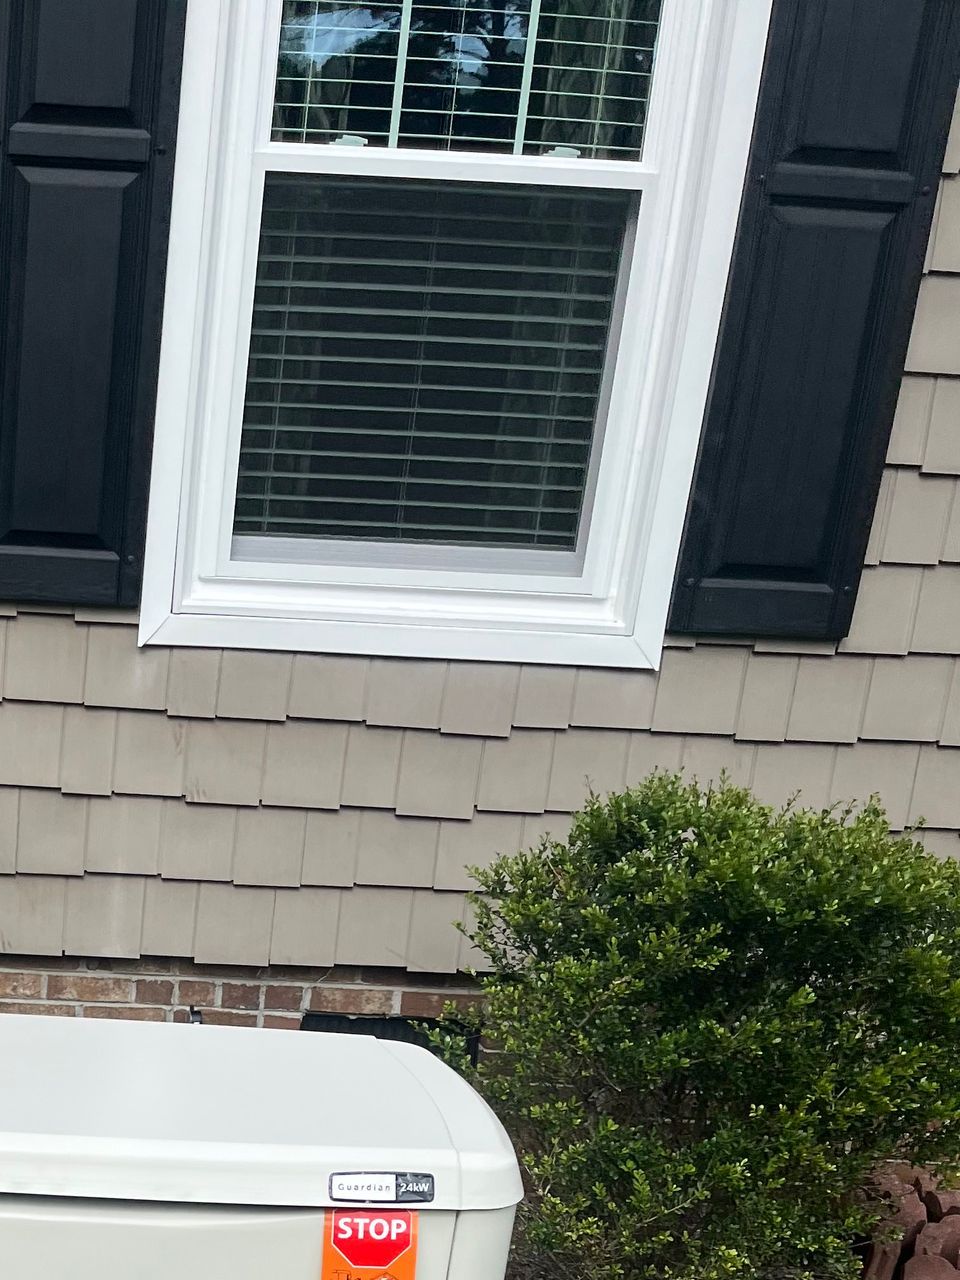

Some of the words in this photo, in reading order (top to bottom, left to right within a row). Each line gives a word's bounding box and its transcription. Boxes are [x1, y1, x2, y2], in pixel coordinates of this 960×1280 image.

[338, 1183, 391, 1191] Guardian
[400, 1183, 429, 1192] 24kW
[337, 1217, 407, 1240] STOP
